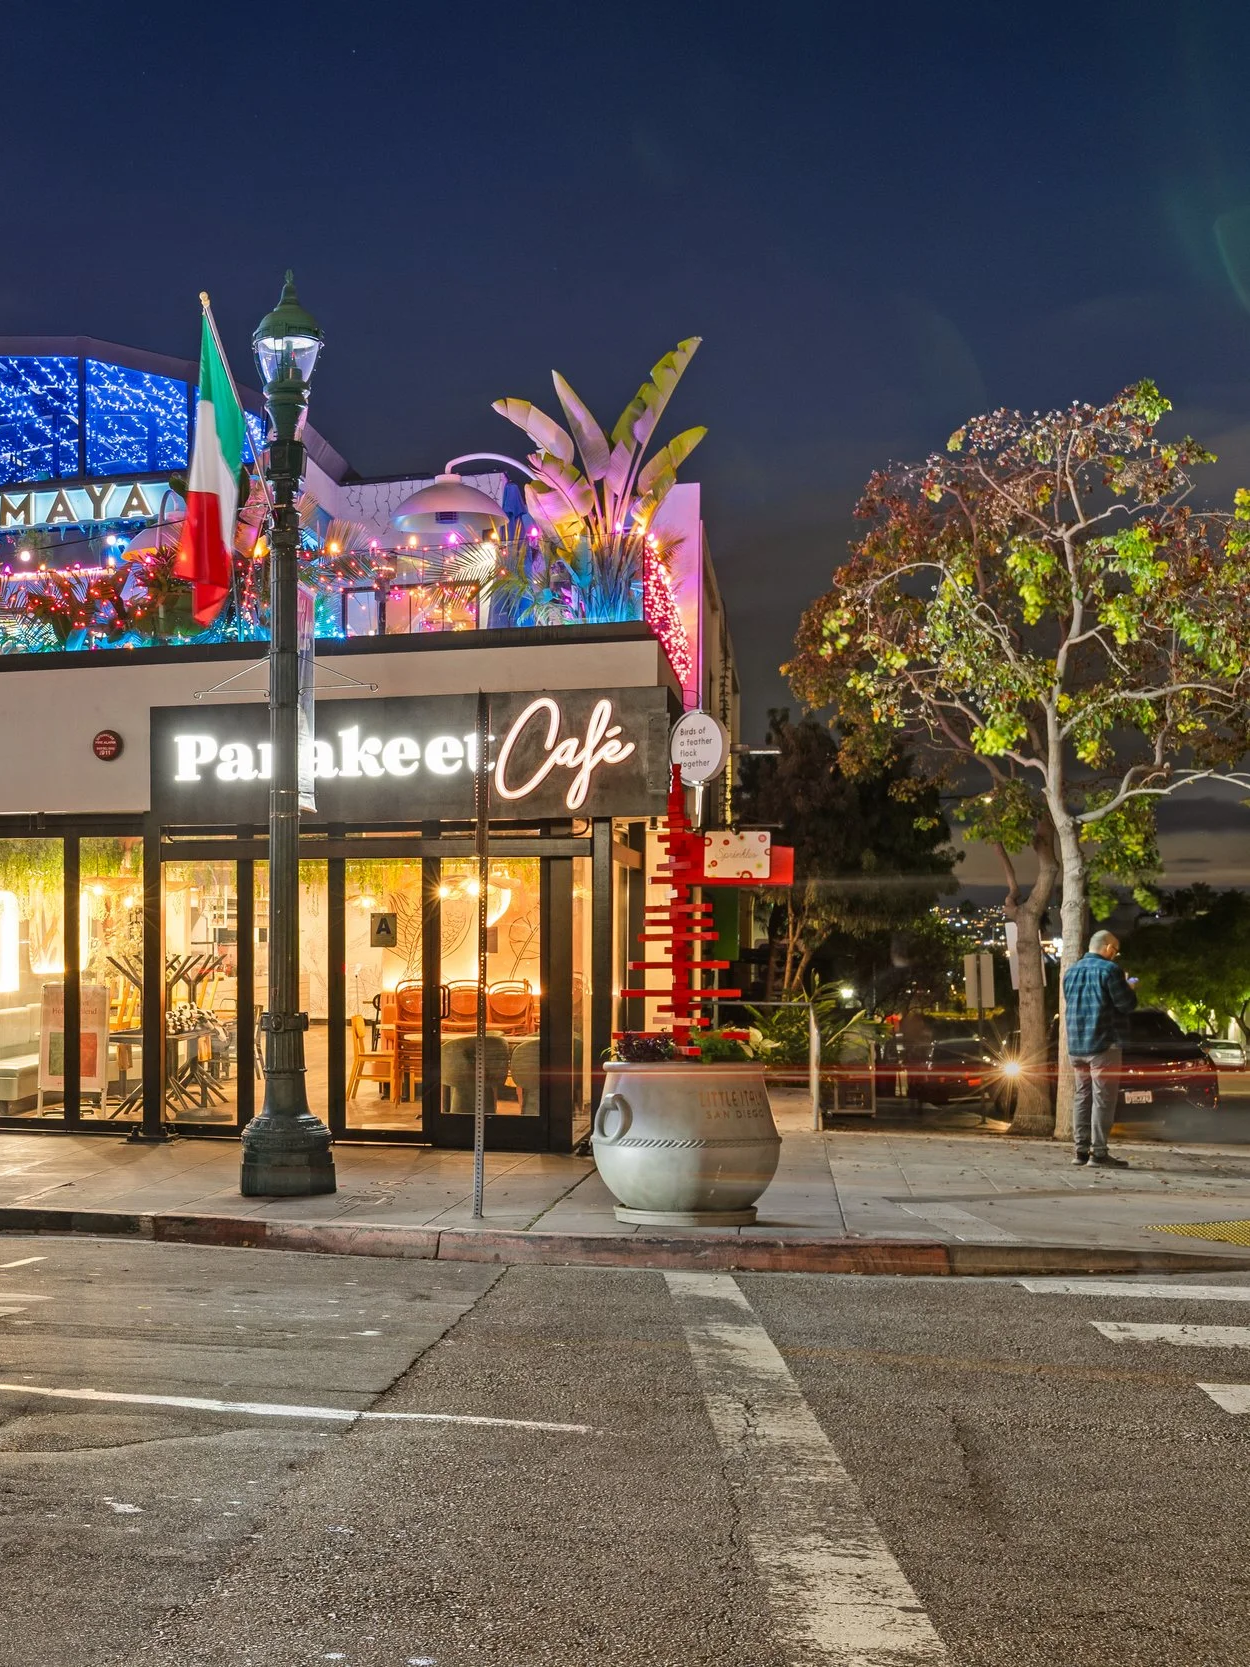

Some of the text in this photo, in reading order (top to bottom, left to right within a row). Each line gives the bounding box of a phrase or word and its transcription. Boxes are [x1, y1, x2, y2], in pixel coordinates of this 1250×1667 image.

[0, 482, 153, 527] MAYA
[680, 726, 706, 736] Birds of
[686, 736, 713, 747] feather
[494, 696, 636, 810] Café
[680, 749, 698, 758] flock
[376, 917, 392, 935] A
[700, 1090, 738, 1108] LITTLE
[705, 1108, 765, 1120] SAN DIEGO
